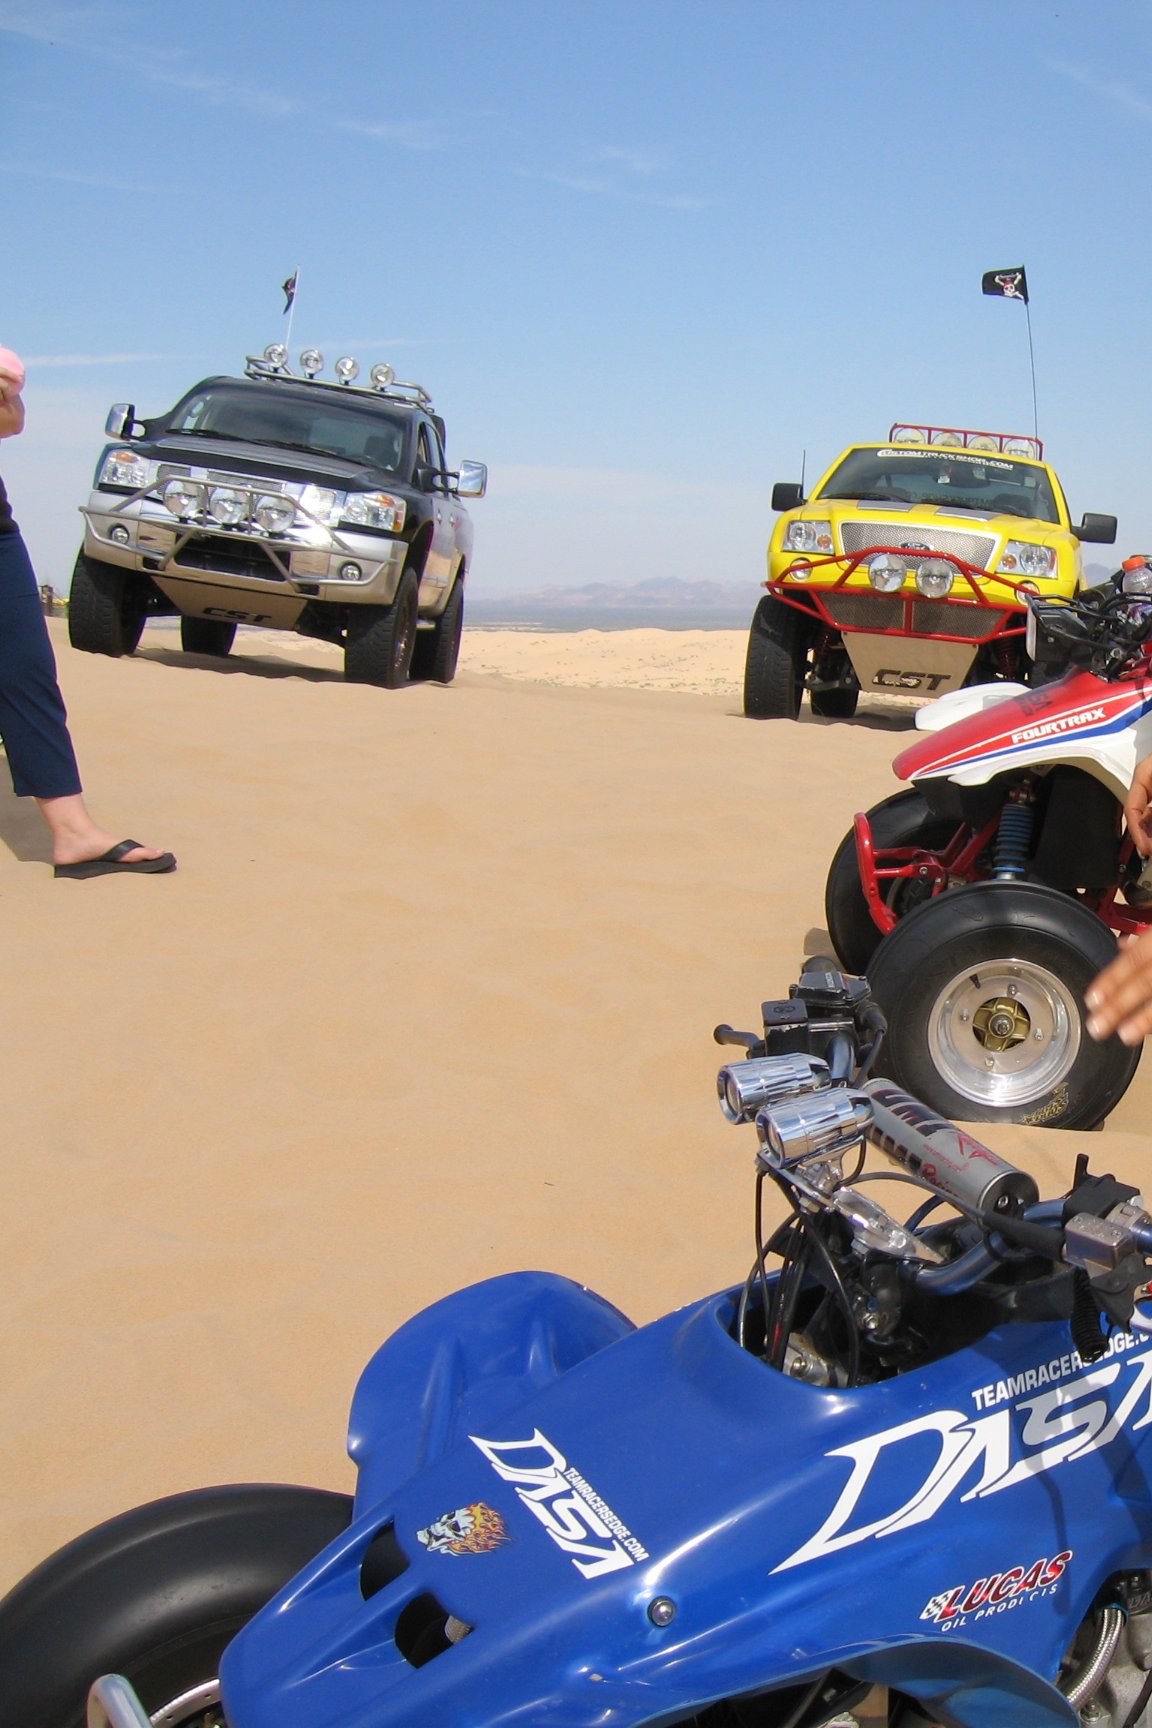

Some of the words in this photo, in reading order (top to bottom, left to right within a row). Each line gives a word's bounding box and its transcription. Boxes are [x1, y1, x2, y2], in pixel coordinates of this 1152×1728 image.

[202, 607, 272, 622] CST
[872, 668, 952, 691] CST
[1011, 707, 1107, 744] FOURTRAX
[468, 1427, 635, 1580] DASA
[563, 1466, 650, 1562] TEAMRACERSEDGE.COM
[933, 1550, 1074, 1623] LUCAS
[941, 1616, 968, 1632] OIL
